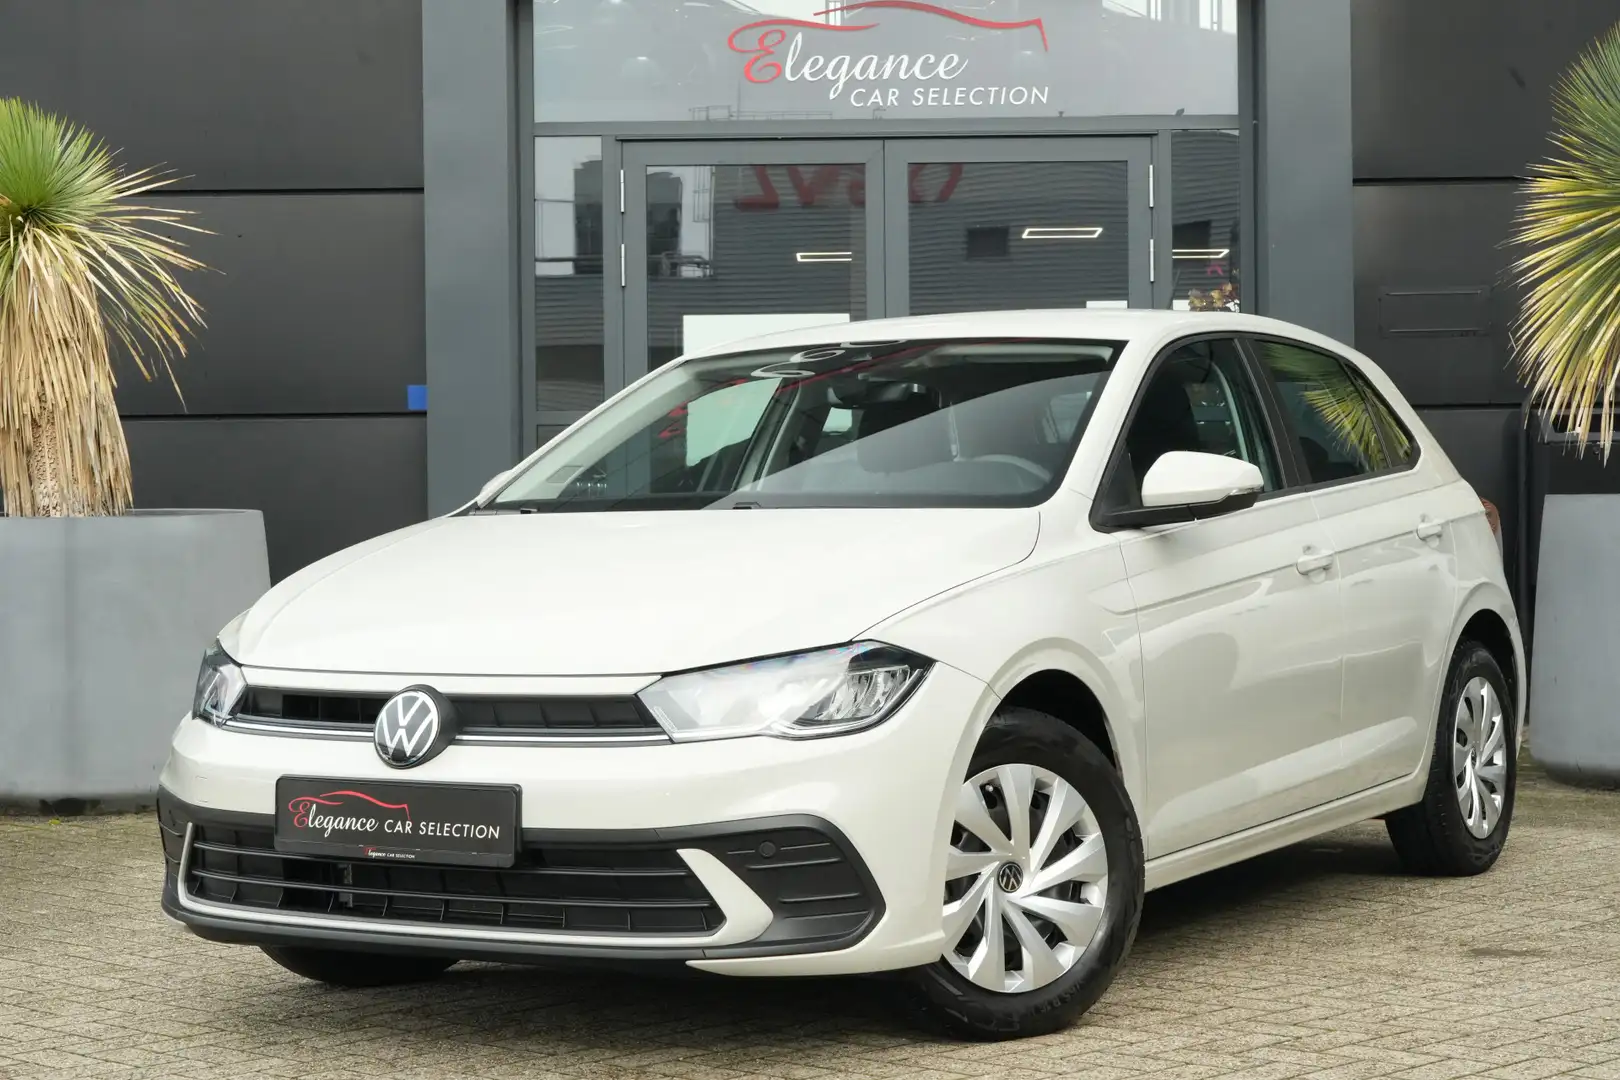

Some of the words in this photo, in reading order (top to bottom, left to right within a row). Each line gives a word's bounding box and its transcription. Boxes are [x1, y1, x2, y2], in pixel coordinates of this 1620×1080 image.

[728, 20, 968, 100] Elegance
[850, 88, 899, 107] CAR
[912, 86, 1049, 106] SELECTION
[289, 797, 379, 837] Elegance
[384, 819, 412, 835] CAR
[419, 822, 500, 839] SELECTION
